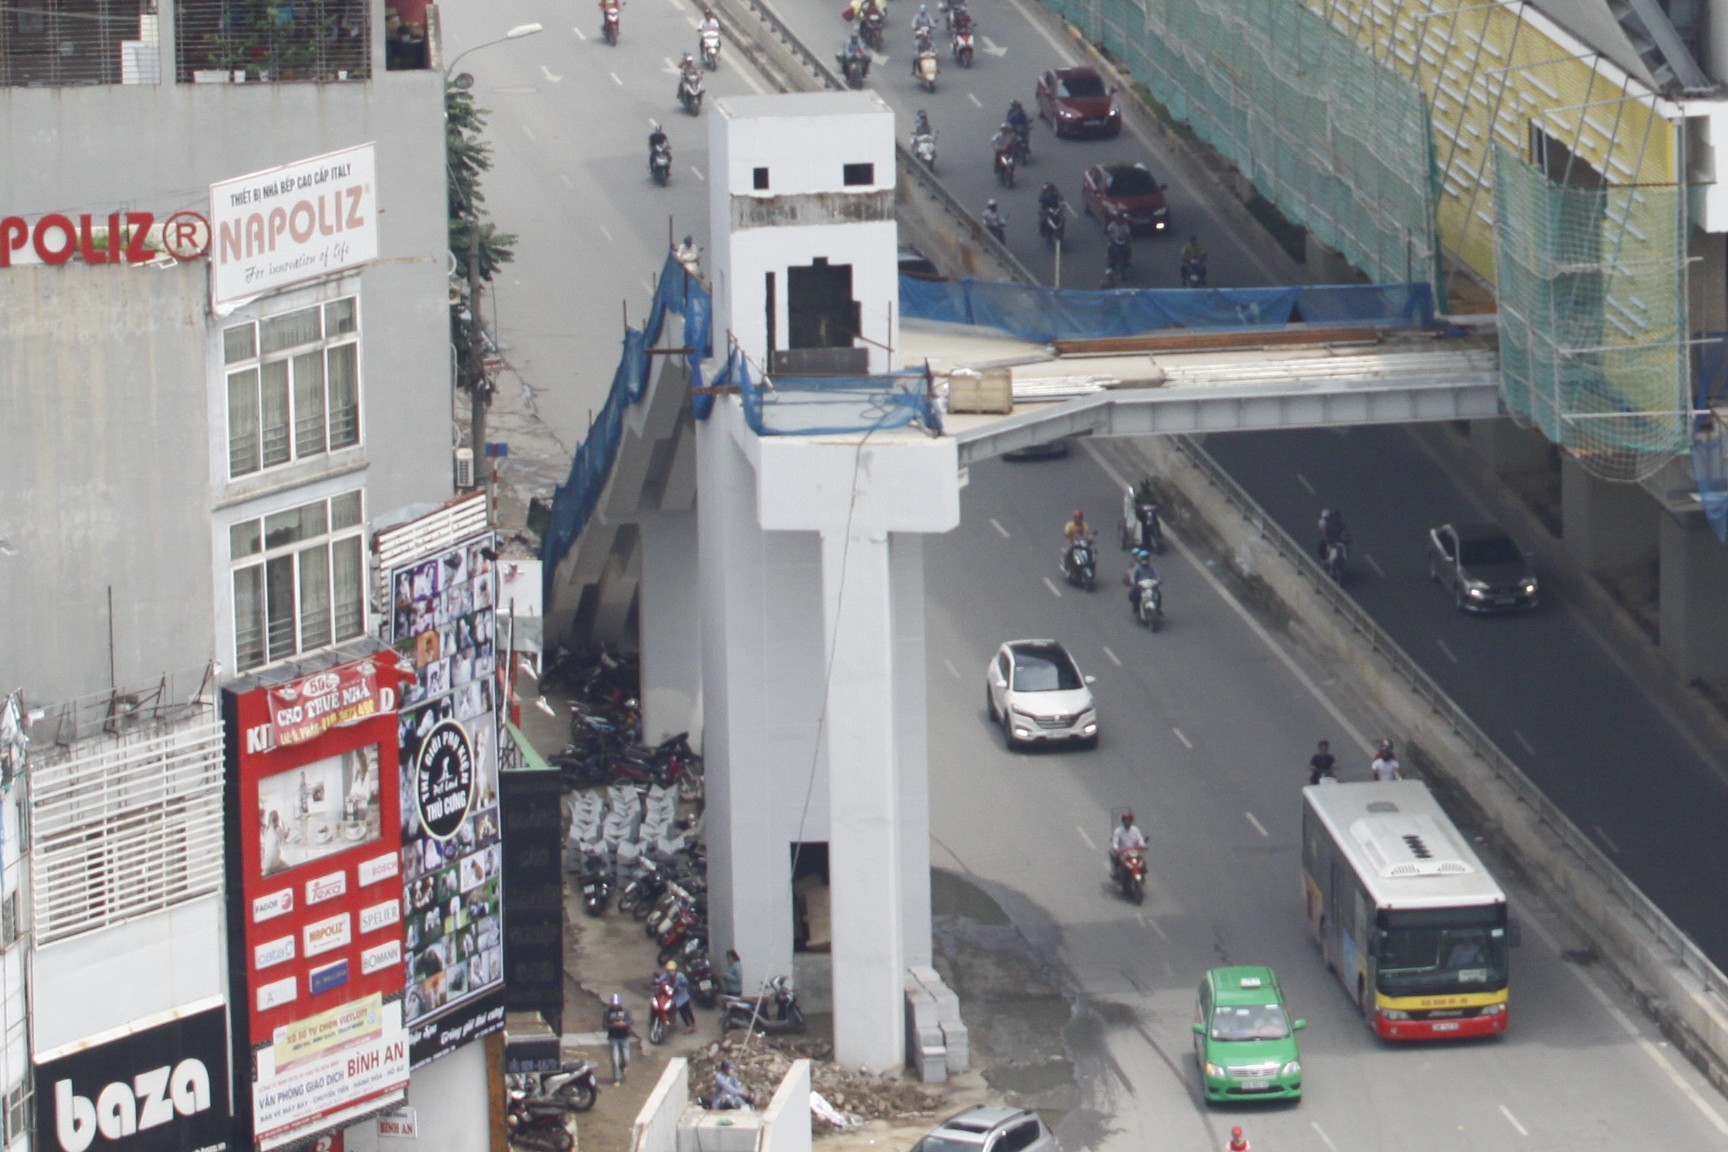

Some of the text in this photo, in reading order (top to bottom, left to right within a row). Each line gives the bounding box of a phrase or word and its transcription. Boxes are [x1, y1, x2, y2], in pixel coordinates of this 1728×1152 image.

[231, 163, 352, 207] THIẾT BỊ NHÀ BẾP CAO CẤP ITALY
[220, 184, 366, 265] NAPOLIZ
[269, 252, 316, 276] innovation
[319, 246, 330, 268] of
[333, 242, 350, 264] life
[277, 706, 303, 728] CHO
[304, 688, 341, 720] THUÊ
[342, 677, 372, 707] NHÀ
[426, 790, 467, 823] THÚ CƯNG
[372, 861, 398, 876] BOSCH
[255, 900, 279, 913] FAGOR
[362, 905, 398, 928] SPELIER
[309, 922, 344, 943] NAPOLIZ
[363, 948, 399, 968] BOMANN
[259, 1094, 276, 1110] VĂN
[277, 1084, 305, 1104] PHÒNG
[305, 1077, 325, 1093] GIAO
[347, 1051, 380, 1078] BÌNH
[384, 1040, 404, 1065] AN
[55, 1057, 212, 1152] baza
[379, 1121, 413, 1135] BÌNH AN
